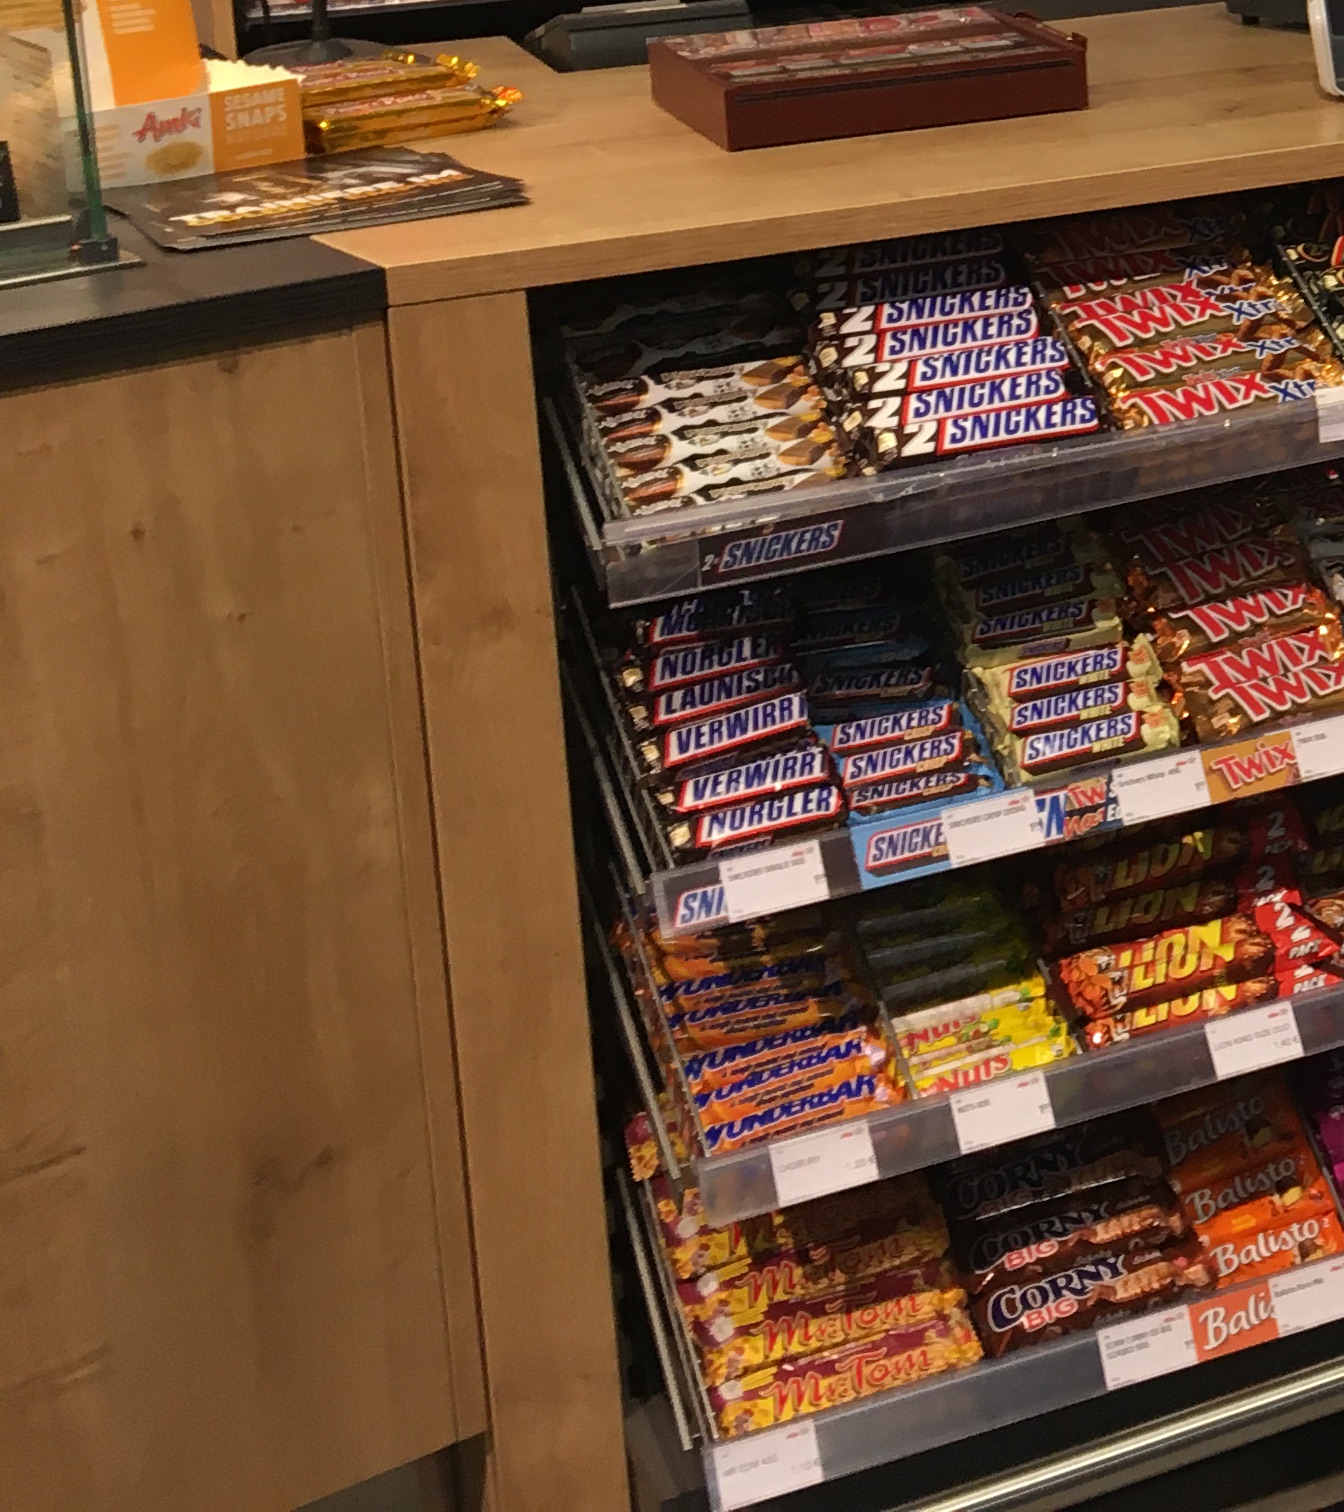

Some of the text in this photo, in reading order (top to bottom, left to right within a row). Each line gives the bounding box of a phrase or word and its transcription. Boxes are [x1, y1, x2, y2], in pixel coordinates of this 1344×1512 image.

[224, 88, 286, 111] SESAME
[225, 106, 288, 131] SNAPS
[846, 307, 1038, 368] 2 SNICKERS
[917, 337, 1066, 383] SNICKERS
[1102, 335, 1246, 381] TWIX
[868, 370, 1064, 430] 2 SNICKERS
[1125, 373, 1270, 425] TWIX
[901, 397, 1097, 456] 2 SNICKERS
[724, 522, 842, 568] SNICKERS
[1169, 583, 1310, 641] TWIX
[1013, 649, 1120, 691] SNICKERS
[836, 705, 946, 744] SNICKERS
[1012, 686, 1121, 727] SNICKERS
[849, 736, 958, 778] SNICKERS
[1027, 715, 1135, 763] SNICKERS
[1274, 902, 1296, 929] 2
[903, 1010, 981, 1053] Nuts
[703, 1073, 878, 1150] WUNDERBAR
[1188, 1153, 1297, 1226] Balisto
[1003, 1238, 1060, 1270] BIG
[1210, 1216, 1321, 1279] Balisto
[989, 1254, 1127, 1333] CORNY
[1022, 1296, 1079, 1332] BIG
